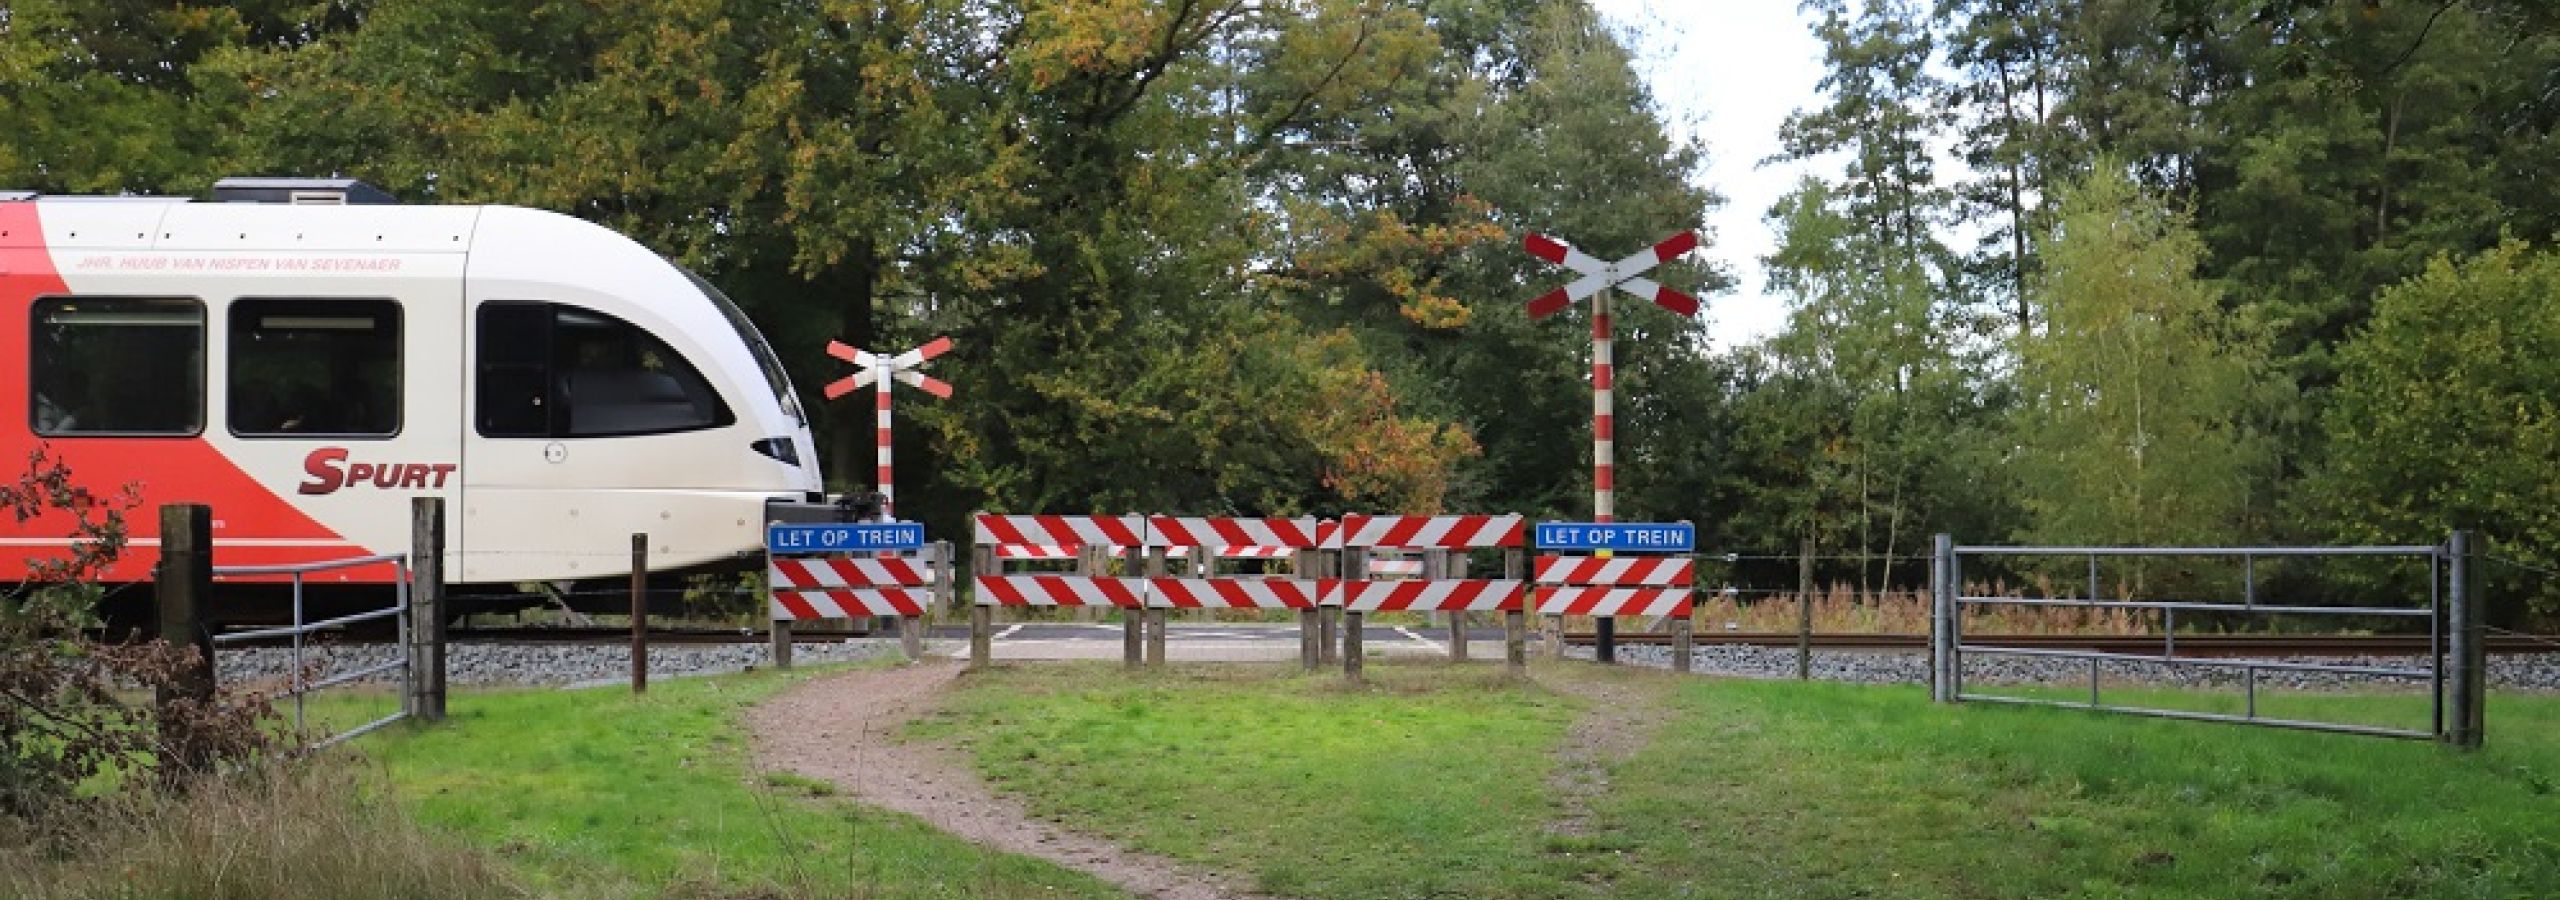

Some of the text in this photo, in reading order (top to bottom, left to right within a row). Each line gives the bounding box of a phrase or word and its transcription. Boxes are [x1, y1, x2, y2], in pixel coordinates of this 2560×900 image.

[173, 258, 206, 270] VAN
[209, 258, 270, 270] NISPEN
[275, 258, 309, 270] VAN
[311, 258, 402, 270] SEVENAER
[777, 529, 915, 547] LET OP TREIN
[1545, 528, 1684, 546] LET OP TREIN
